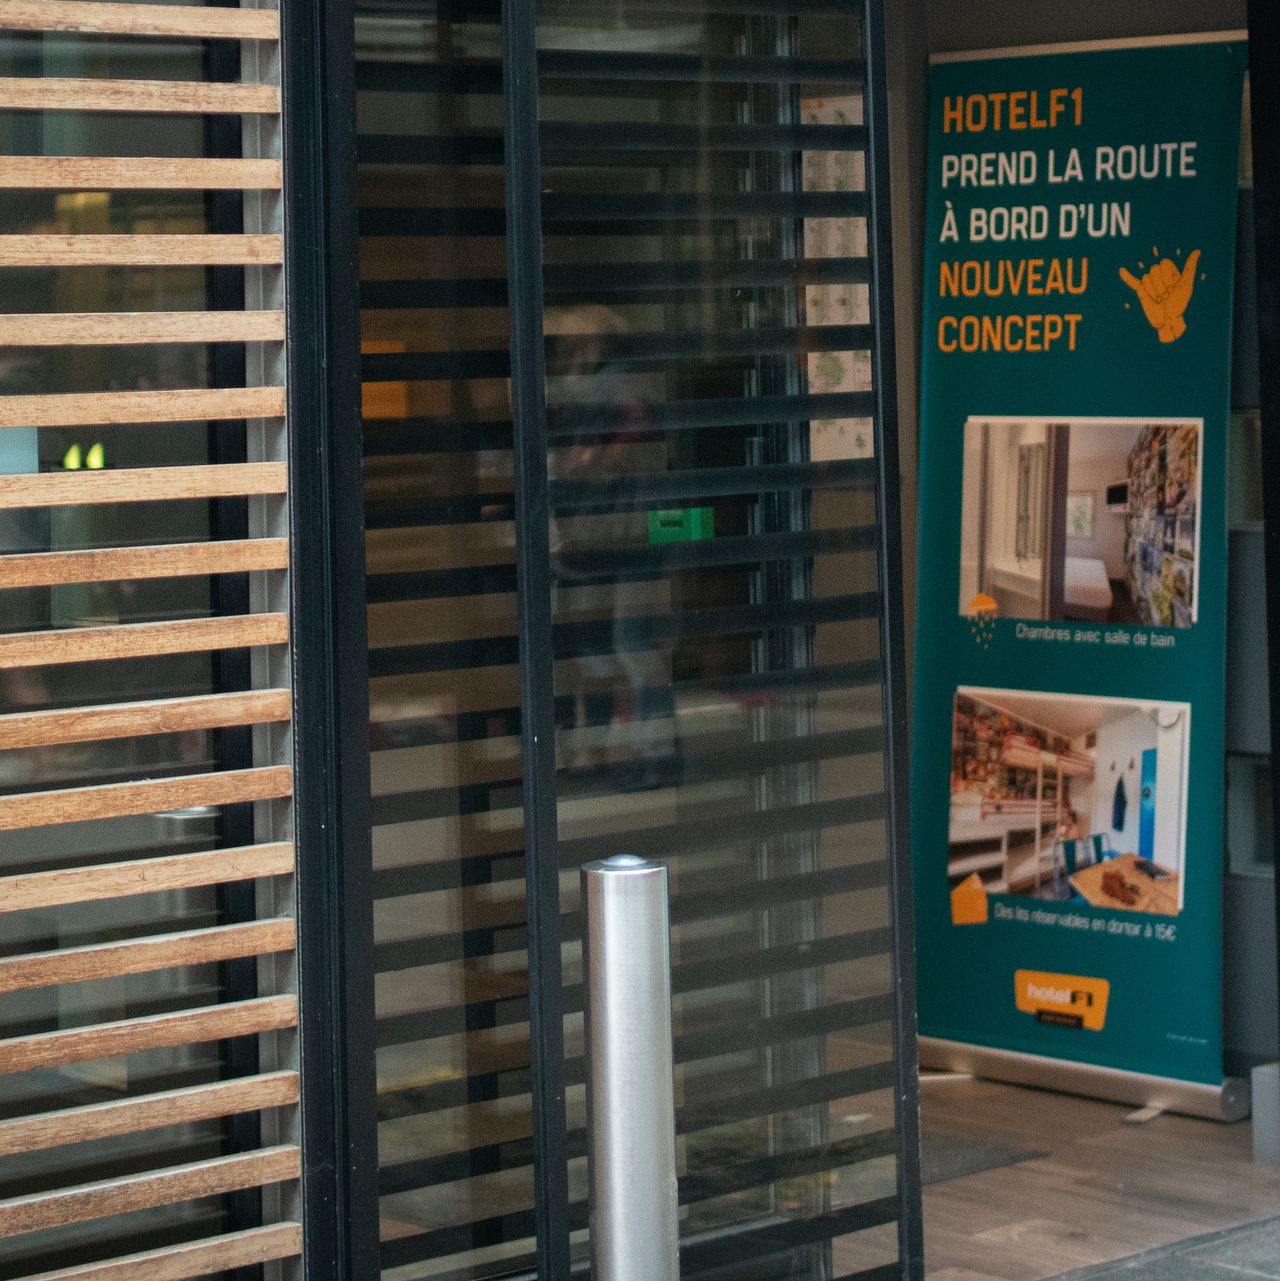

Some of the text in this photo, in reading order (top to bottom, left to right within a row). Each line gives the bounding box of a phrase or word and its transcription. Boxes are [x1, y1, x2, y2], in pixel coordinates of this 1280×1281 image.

[942, 87, 1083, 133] HOTELF1
[941, 141, 1198, 188] PREND LA ROUTE
[939, 200, 1131, 243] À BORD D'UN
[939, 257, 1088, 297] NOUVEAU
[937, 314, 1083, 352] CONCEPT
[1015, 623, 1176, 647] Chambres avec salle de bain
[1027, 982, 1094, 1008] hotelF1
